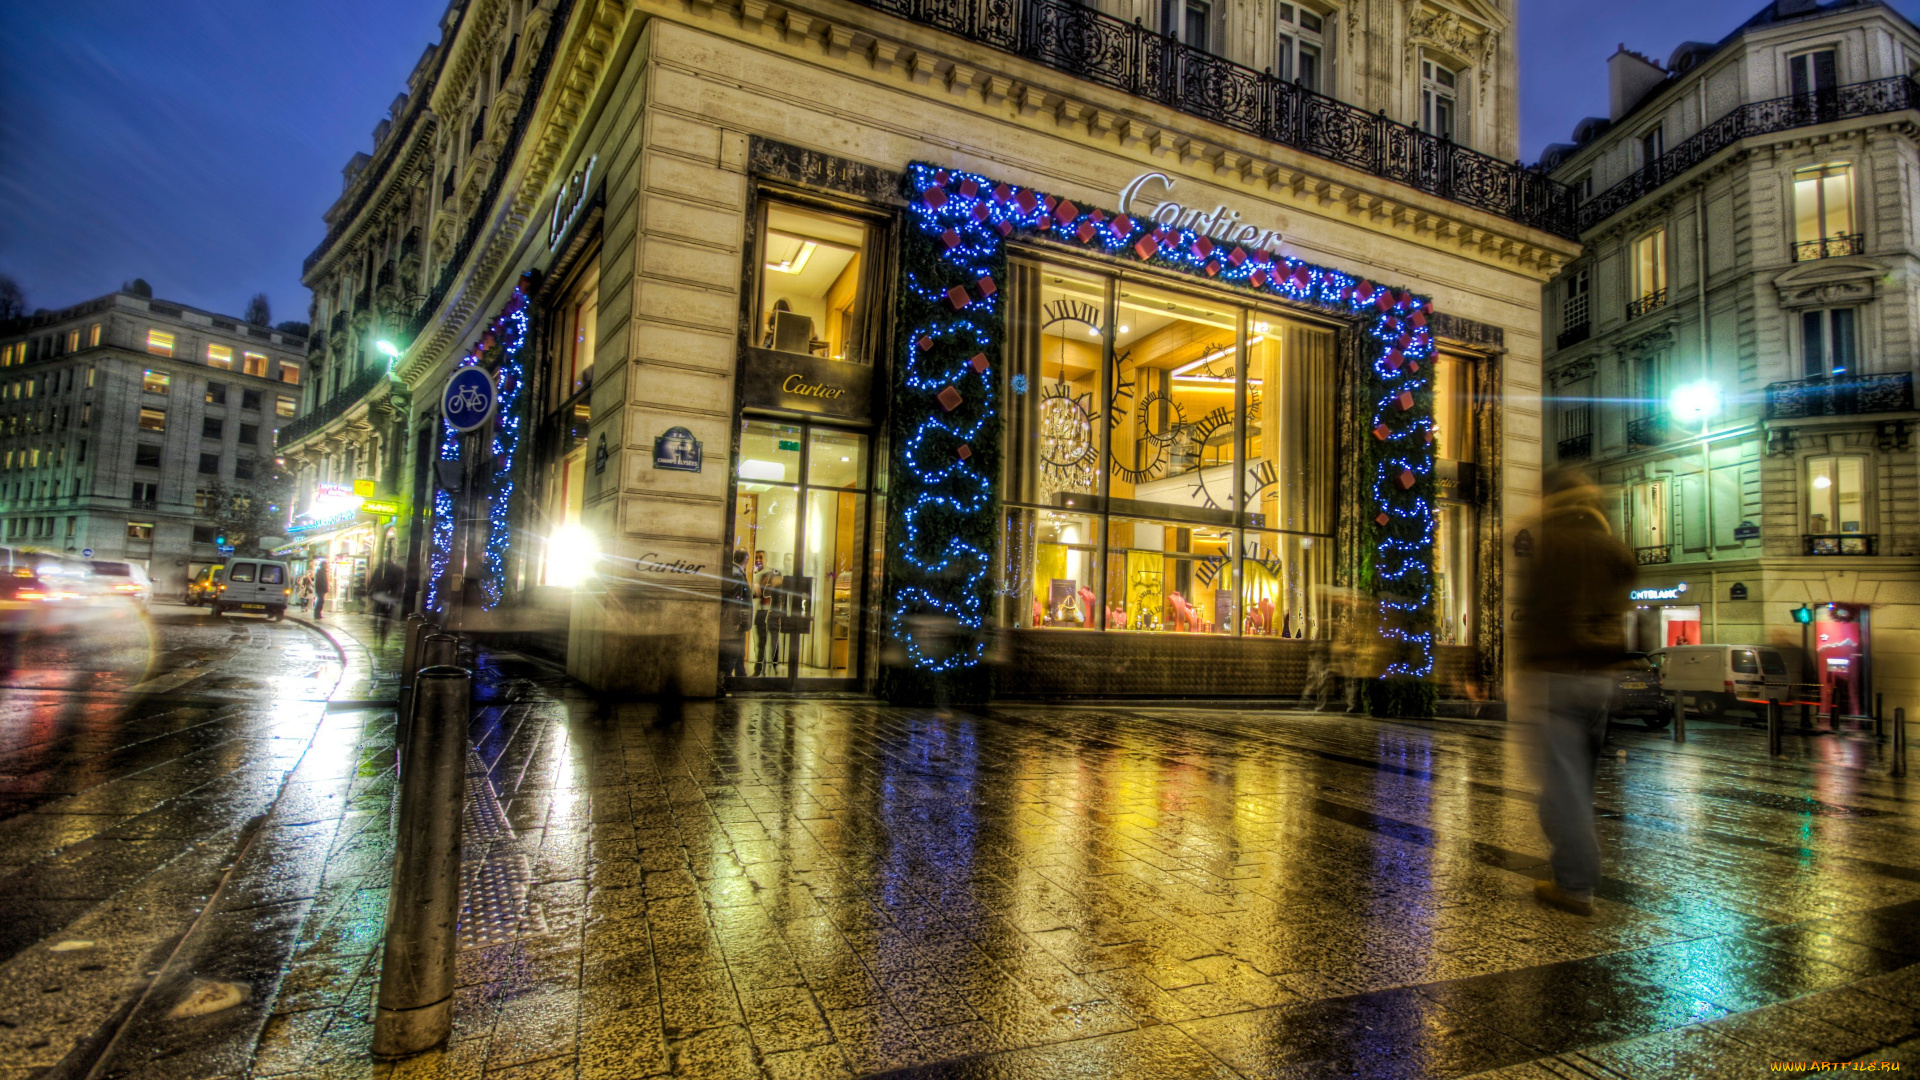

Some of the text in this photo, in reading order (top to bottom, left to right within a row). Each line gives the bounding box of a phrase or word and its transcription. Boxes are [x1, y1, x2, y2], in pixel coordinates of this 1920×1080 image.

[1120, 172, 1282, 250] Cartier
[782, 373, 846, 399] Cartier
[635, 553, 705, 574] Cartier
[1630, 588, 1680, 600] ONTBLANC
